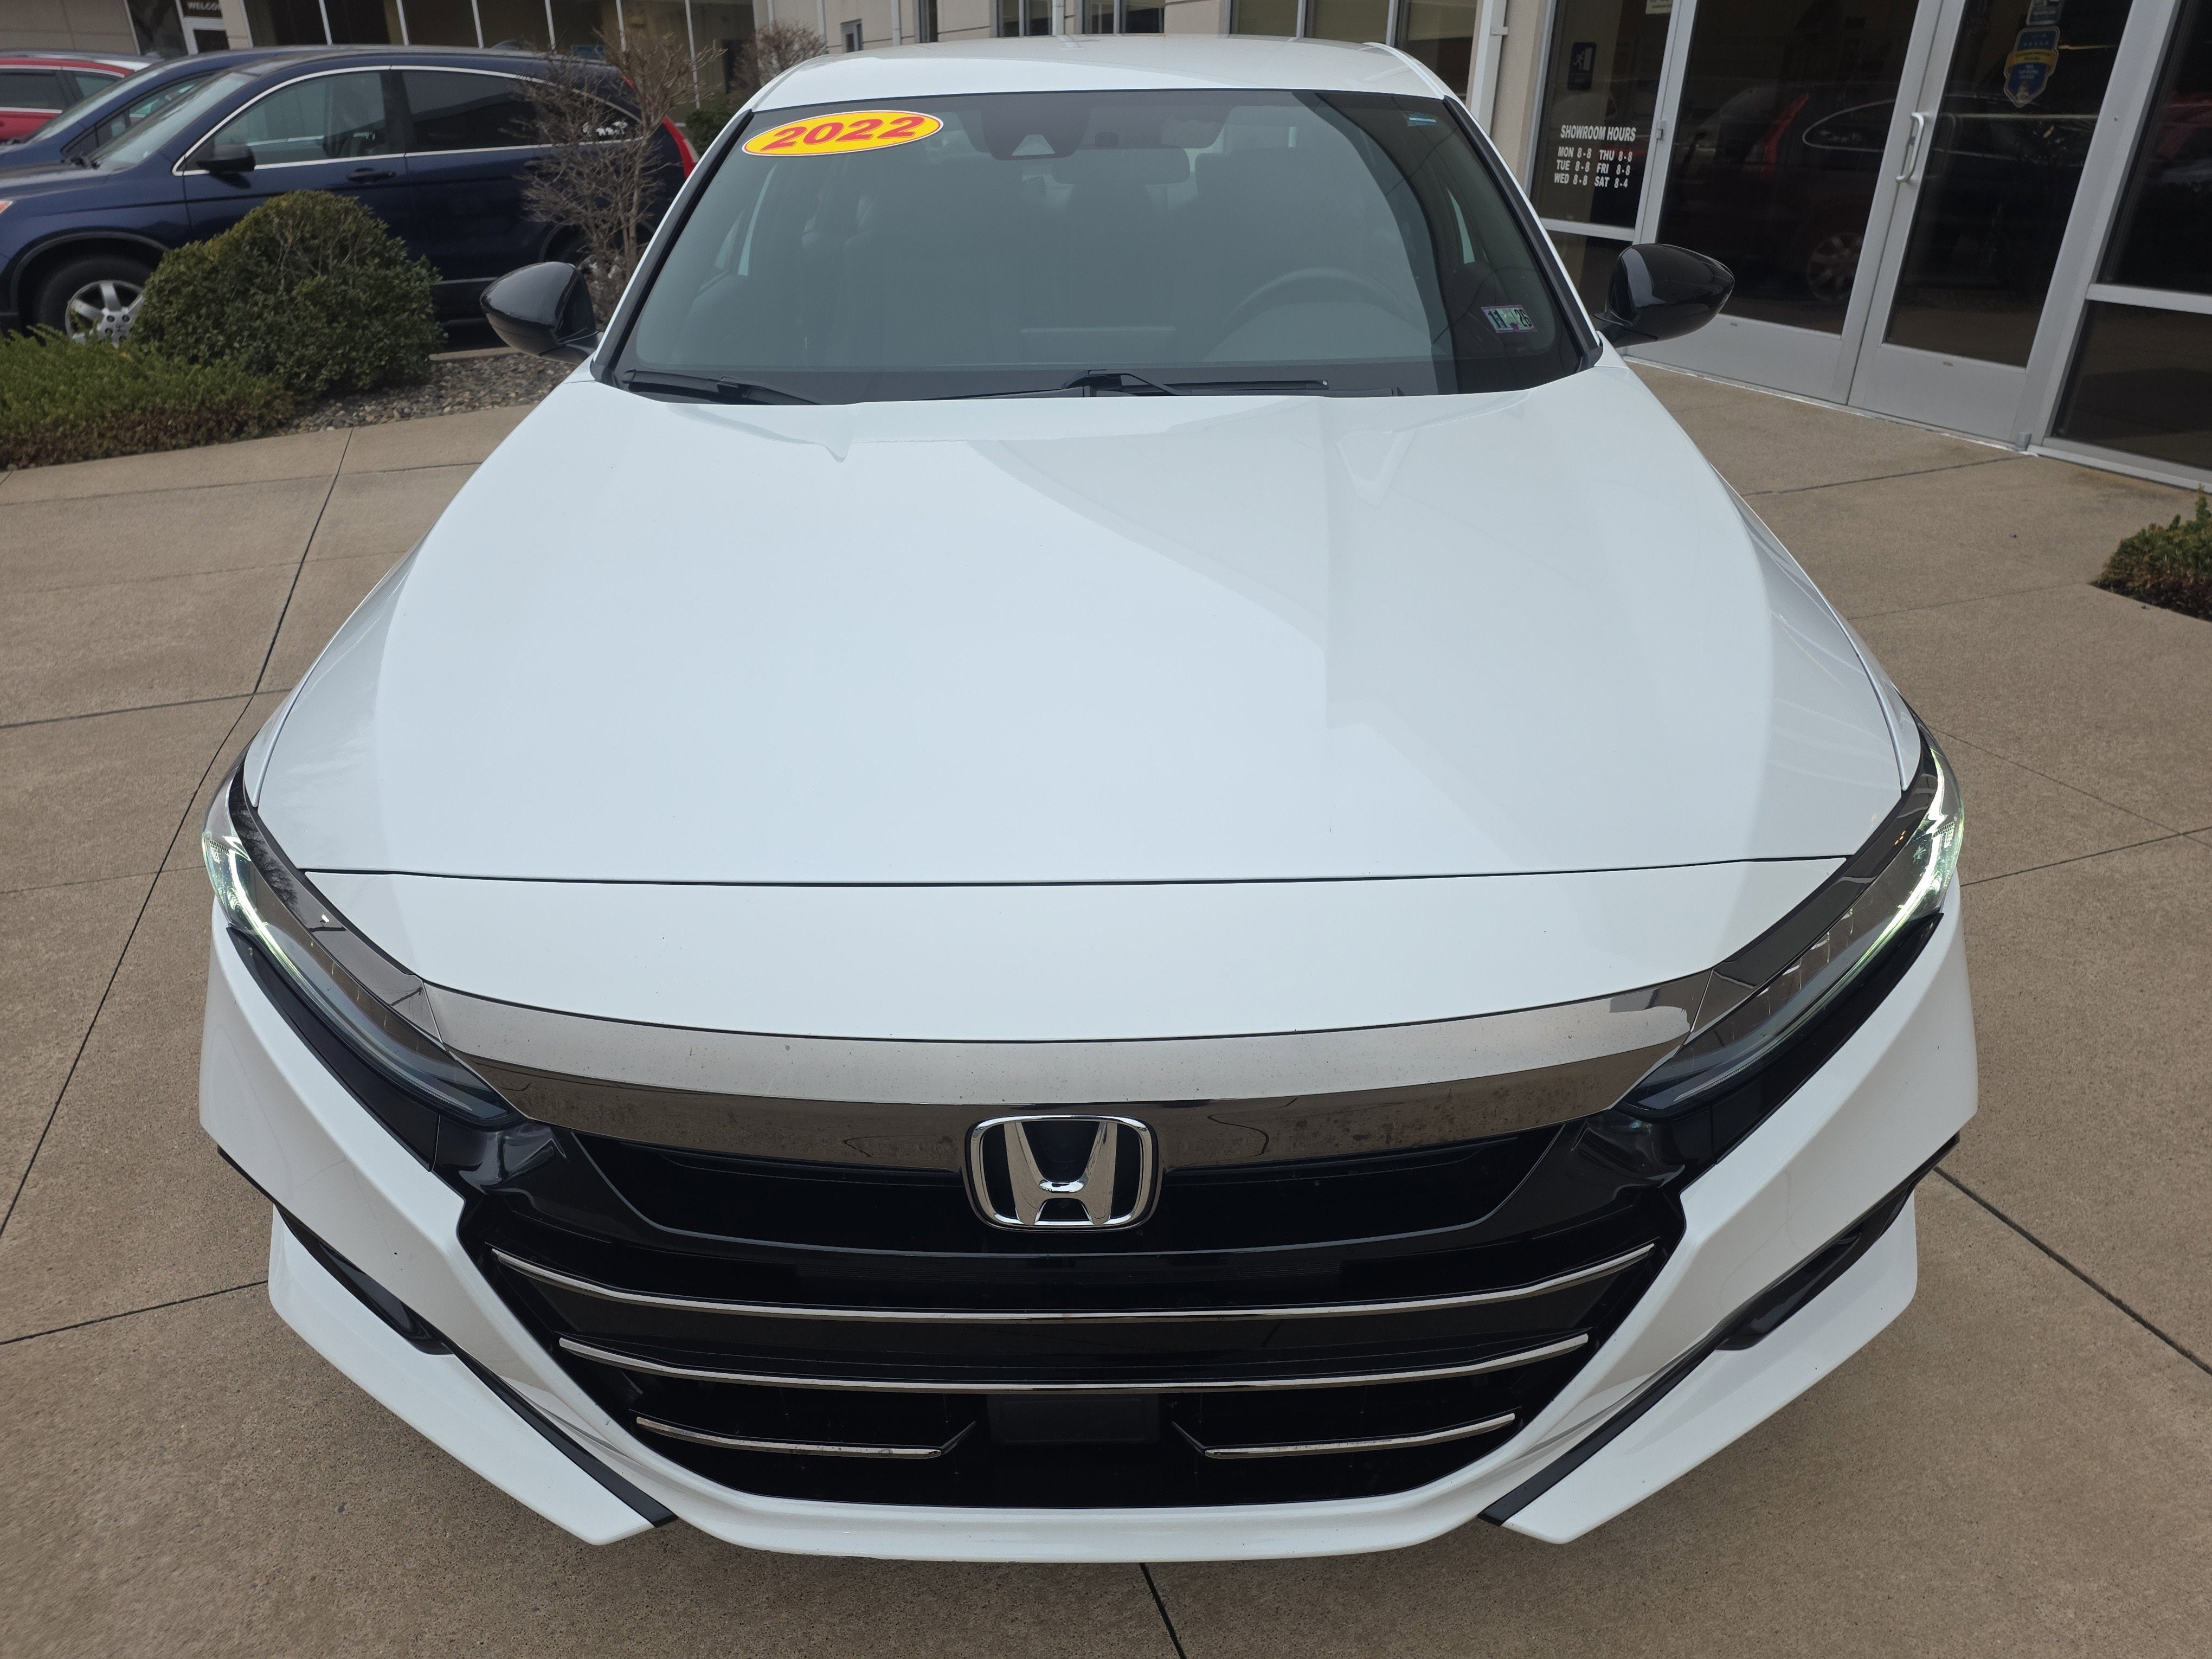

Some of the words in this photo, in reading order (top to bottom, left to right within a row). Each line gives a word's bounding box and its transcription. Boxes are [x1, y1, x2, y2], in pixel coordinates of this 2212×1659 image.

[759, 116, 926, 151] 2022
[1560, 125, 1606, 140] SHOWROOM
[1607, 126, 1636, 142] HOURS
[1558, 146, 1574, 157] MON
[1599, 150, 1615, 161] THU
[1557, 159, 1571, 171] TUE
[1597, 163, 1609, 173] FRI
[1554, 172, 1570, 184] WED
[1594, 176, 1610, 187] SAT
